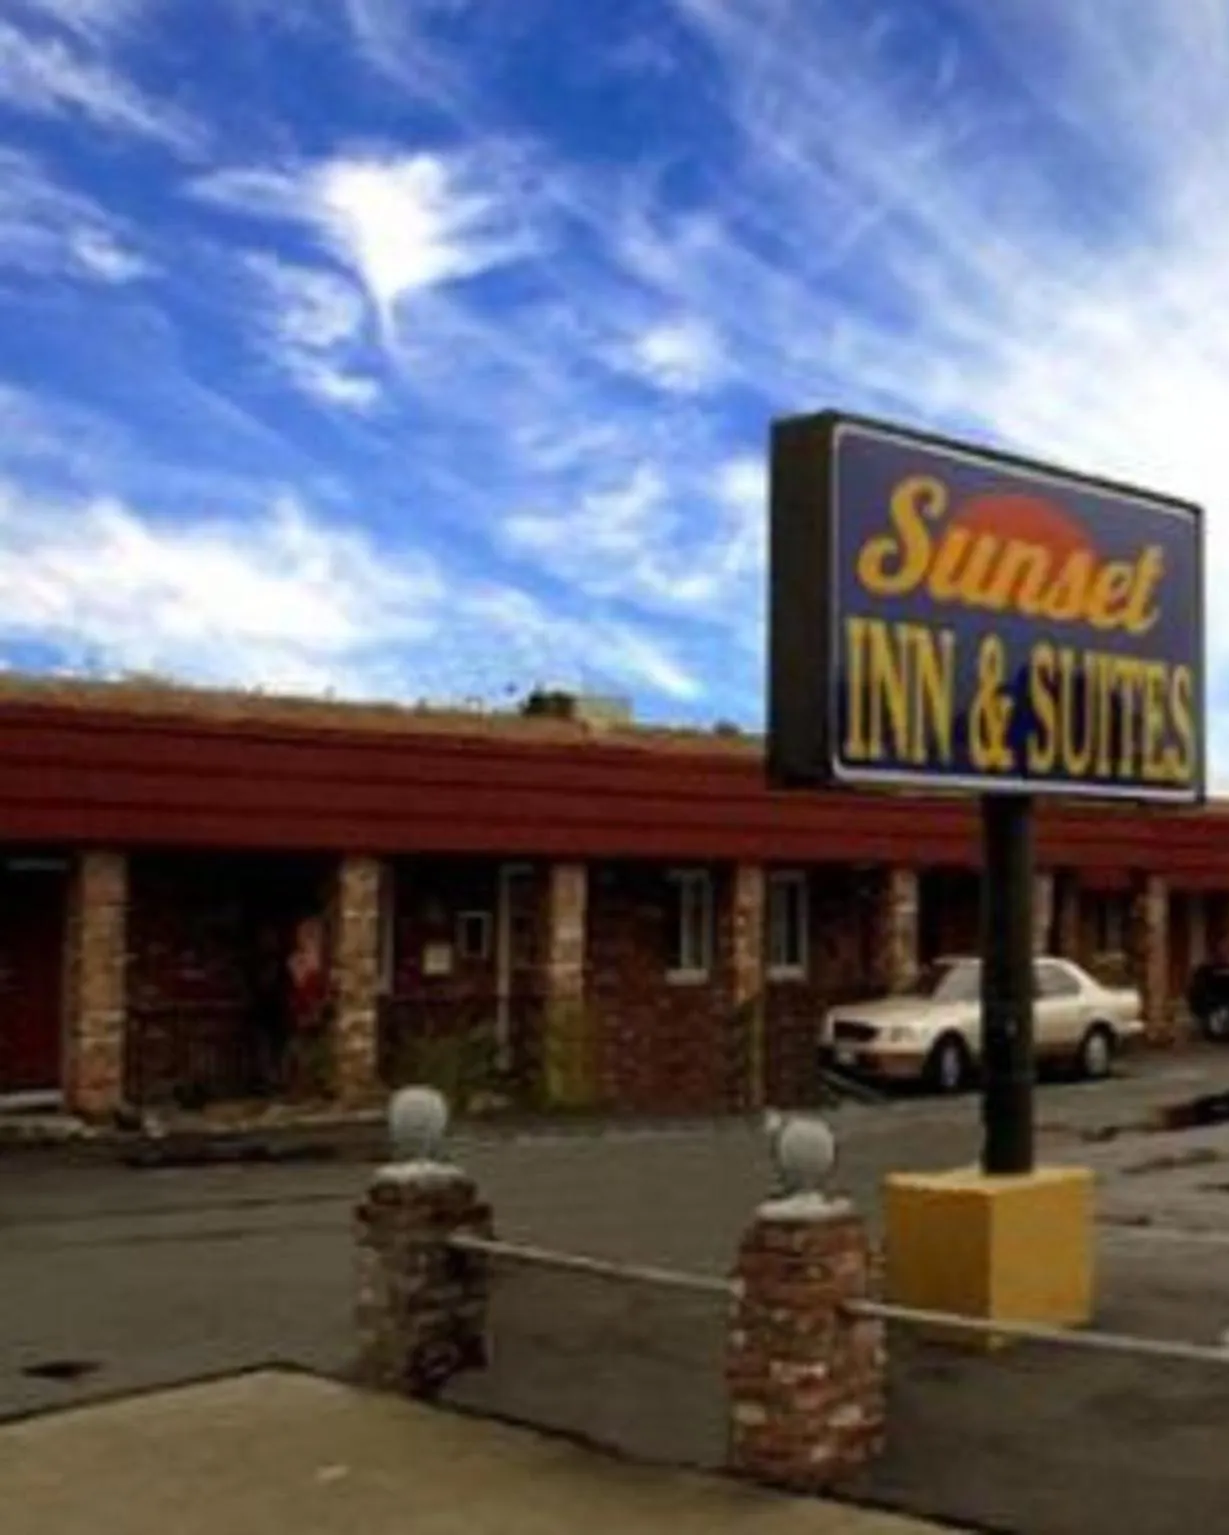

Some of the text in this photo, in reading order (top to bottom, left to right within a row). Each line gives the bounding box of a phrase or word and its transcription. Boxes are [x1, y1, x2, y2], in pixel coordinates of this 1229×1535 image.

[857, 475, 1164, 634] Sunset
[845, 617, 1195, 781] INN & SUITES
